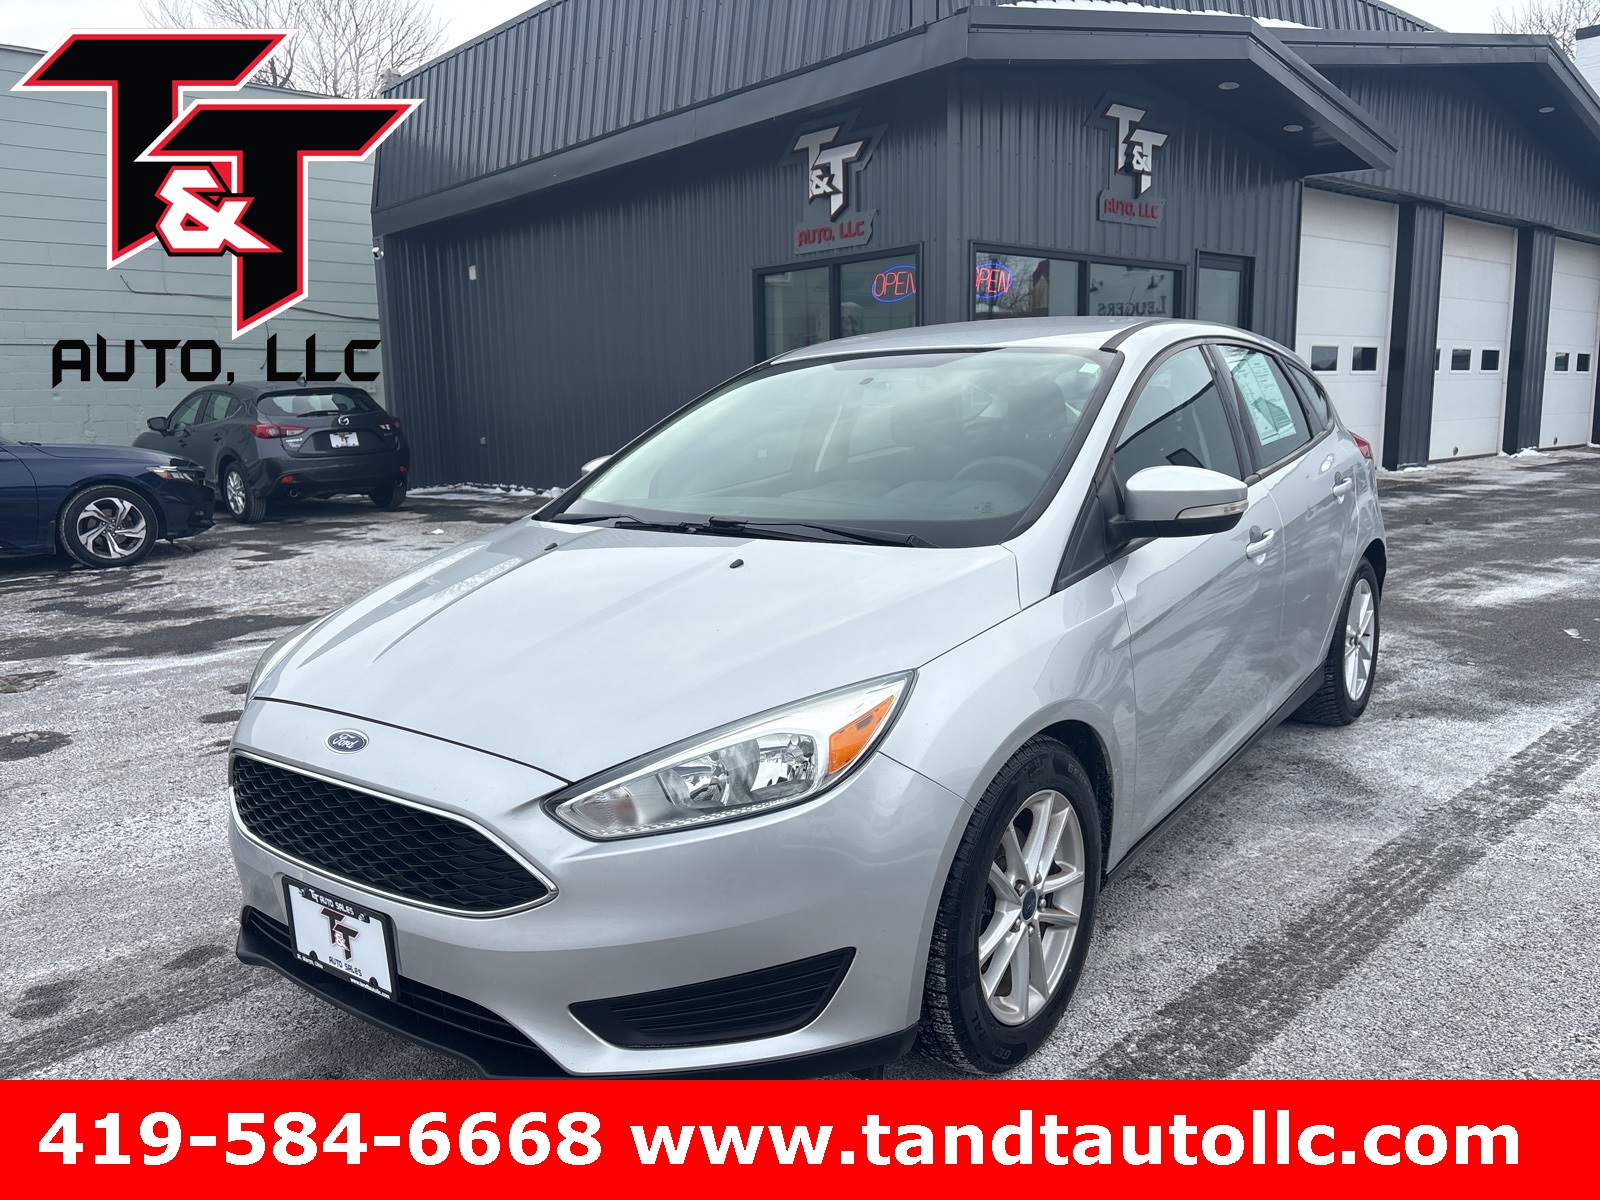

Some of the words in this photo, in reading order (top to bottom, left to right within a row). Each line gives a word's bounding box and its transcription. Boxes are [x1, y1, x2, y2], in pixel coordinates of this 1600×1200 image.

[1104, 102, 1168, 195] T&T
[792, 124, 865, 219] T&T
[1104, 198, 1135, 217] AUTO,
[1139, 202, 1159, 219] LLC
[797, 227, 835, 247] AUTO,
[839, 220, 865, 239] LLC
[873, 270, 916, 297] OPEN
[332, 733, 359, 749] Ford
[320, 906, 360, 961] T&T
[329, 956, 343, 969] AUTO
[344, 963, 363, 976] SALES
